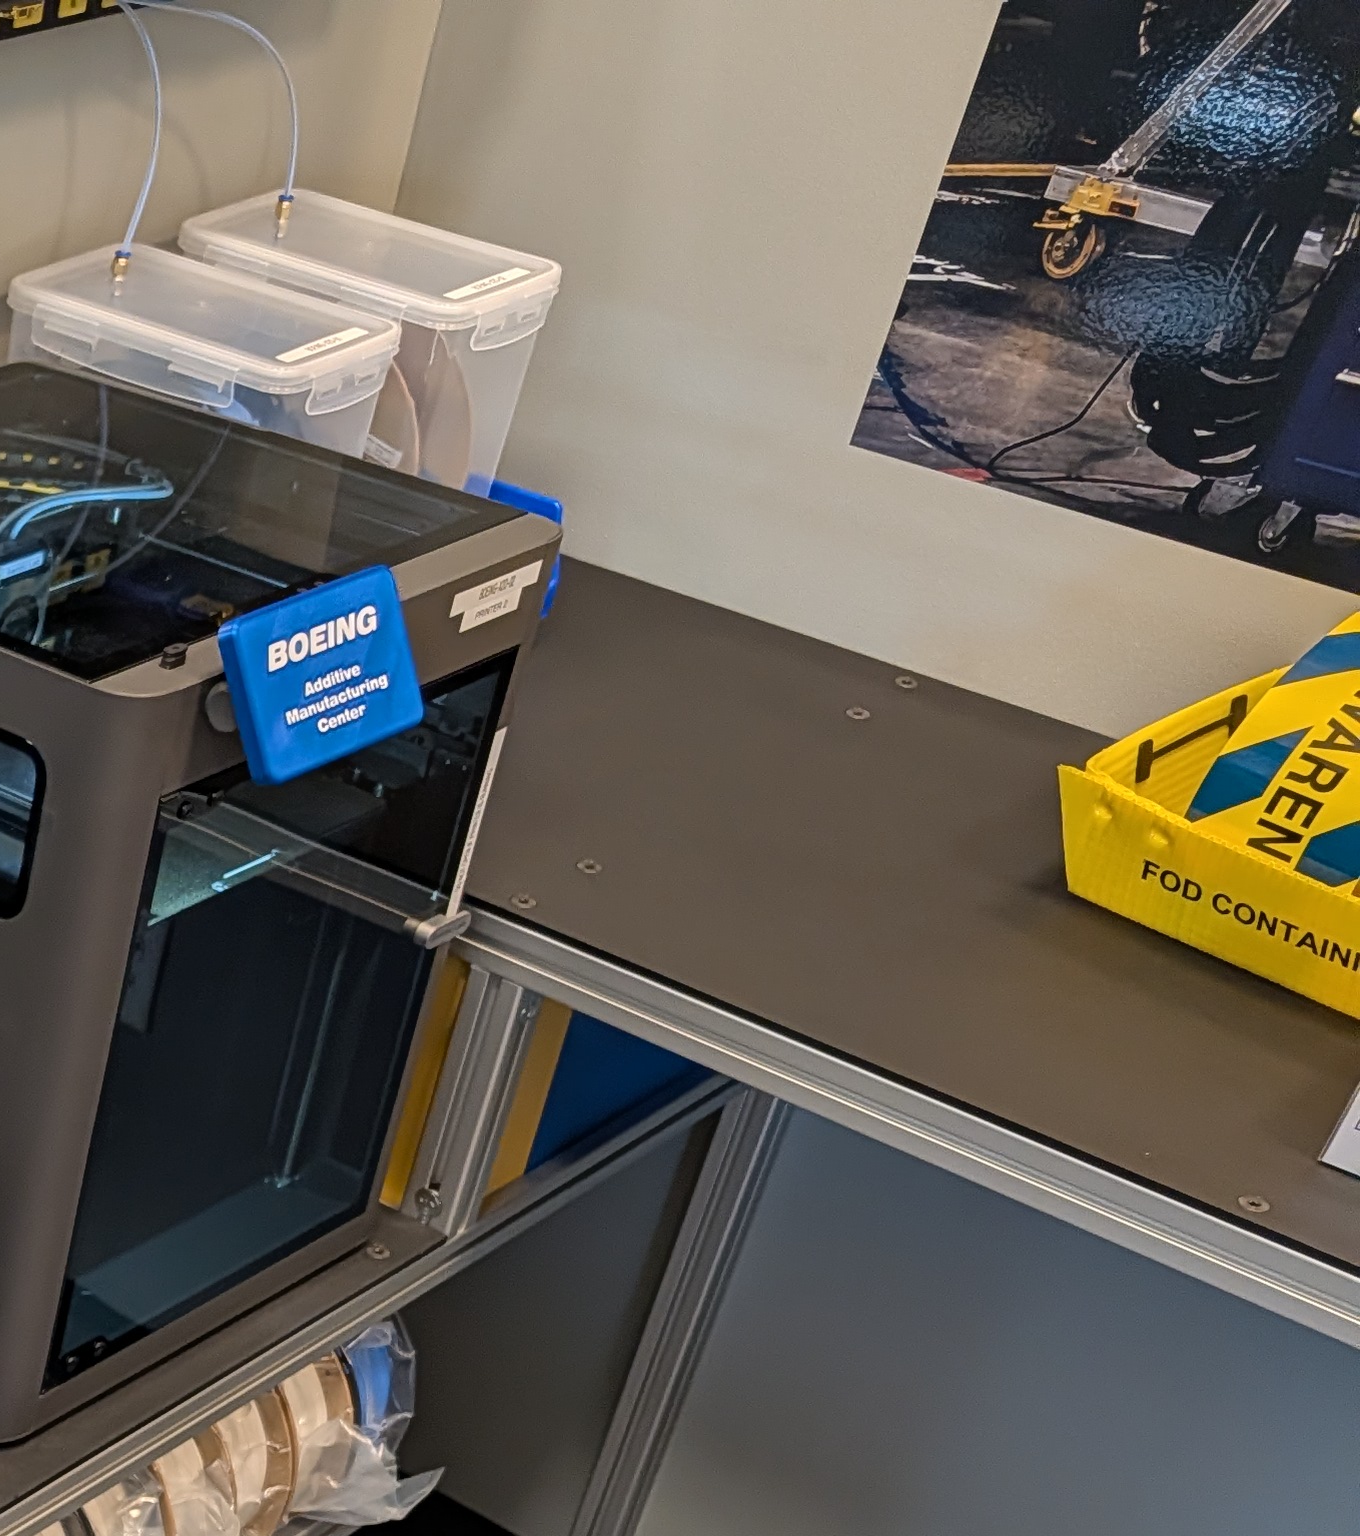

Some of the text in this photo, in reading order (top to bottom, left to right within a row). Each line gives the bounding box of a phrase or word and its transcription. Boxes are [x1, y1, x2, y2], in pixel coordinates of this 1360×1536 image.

[268, 605, 377, 673] BOEING
[304, 664, 361, 697] Additive
[317, 704, 367, 733] Center
[1141, 860, 1360, 972] FOD CONTAIN
